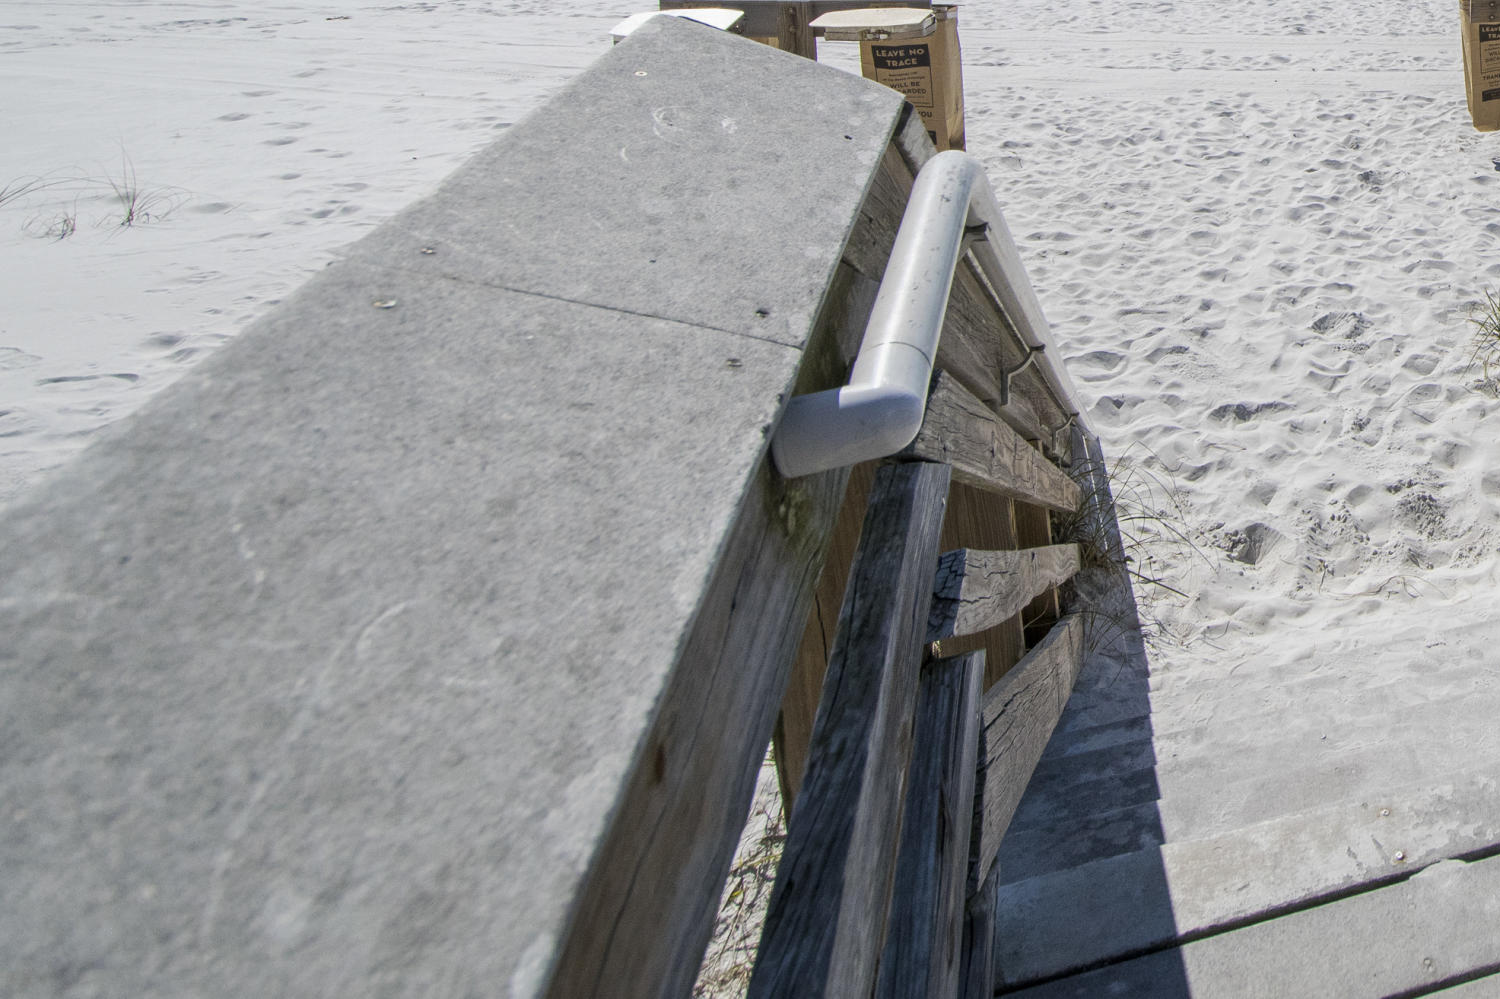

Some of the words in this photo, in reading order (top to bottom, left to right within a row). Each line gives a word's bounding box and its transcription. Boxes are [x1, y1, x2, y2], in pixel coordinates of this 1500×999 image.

[875, 49, 905, 57] LEAVE
[909, 48, 925, 56] NO
[886, 58, 918, 67] TRACE
